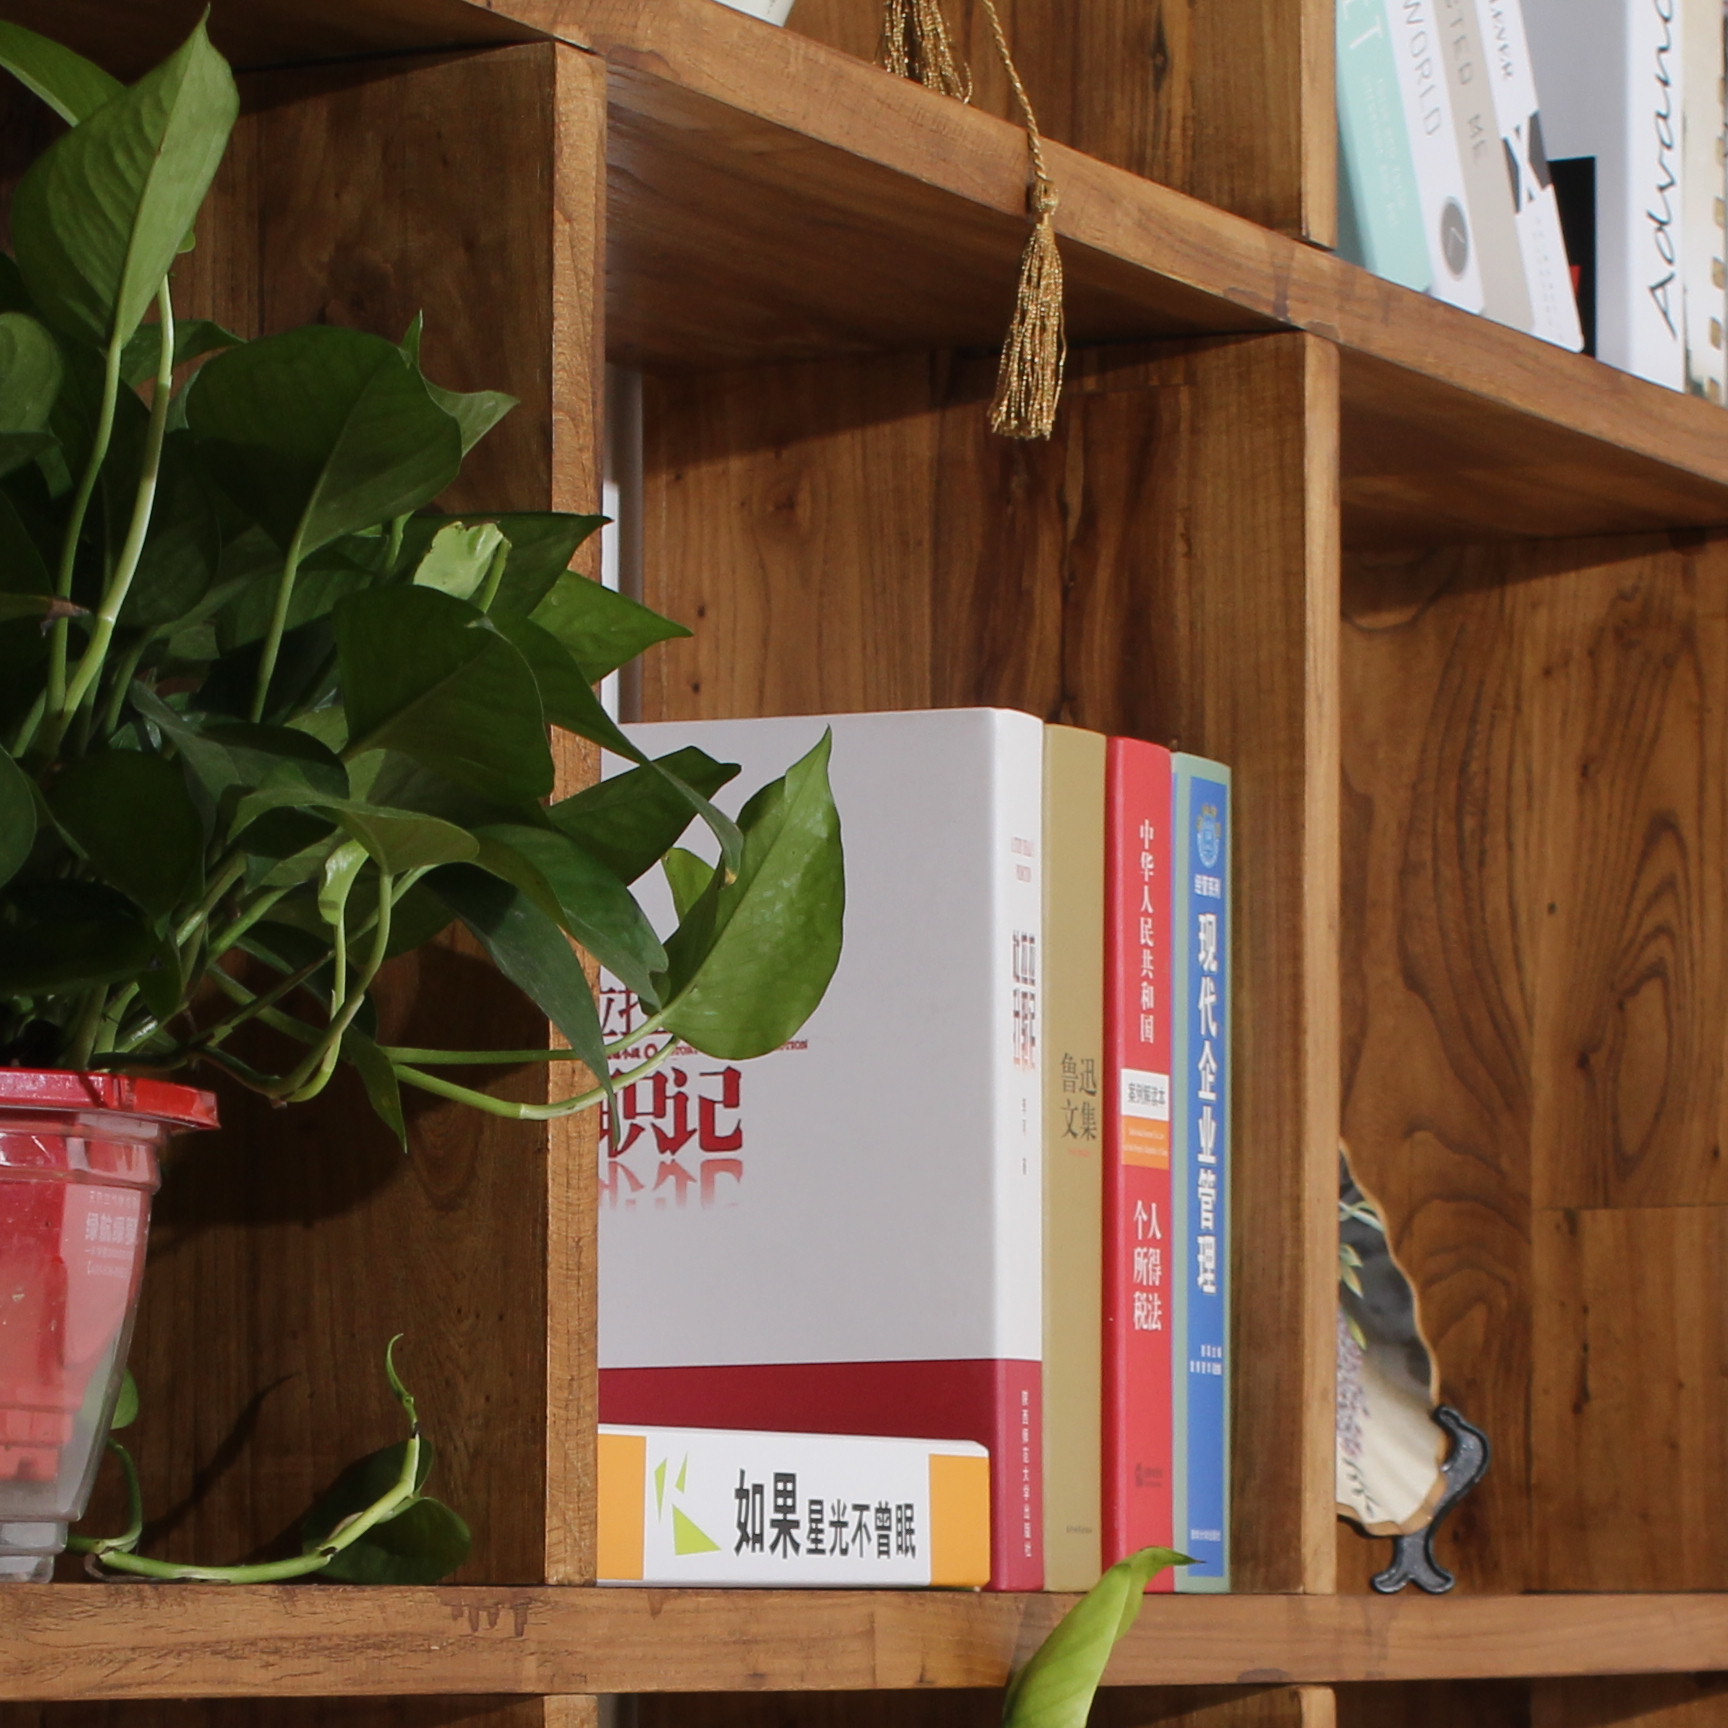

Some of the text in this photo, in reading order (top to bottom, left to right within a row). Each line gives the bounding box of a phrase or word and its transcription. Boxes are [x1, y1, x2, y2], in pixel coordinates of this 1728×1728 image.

[1139, 818, 1155, 1045] 中华人民共和国
[1060, 1052, 1097, 1097] 鲁迅
[1060, 1098, 1097, 1141] 文集
[1197, 913, 1219, 1295] 现代企业管理
